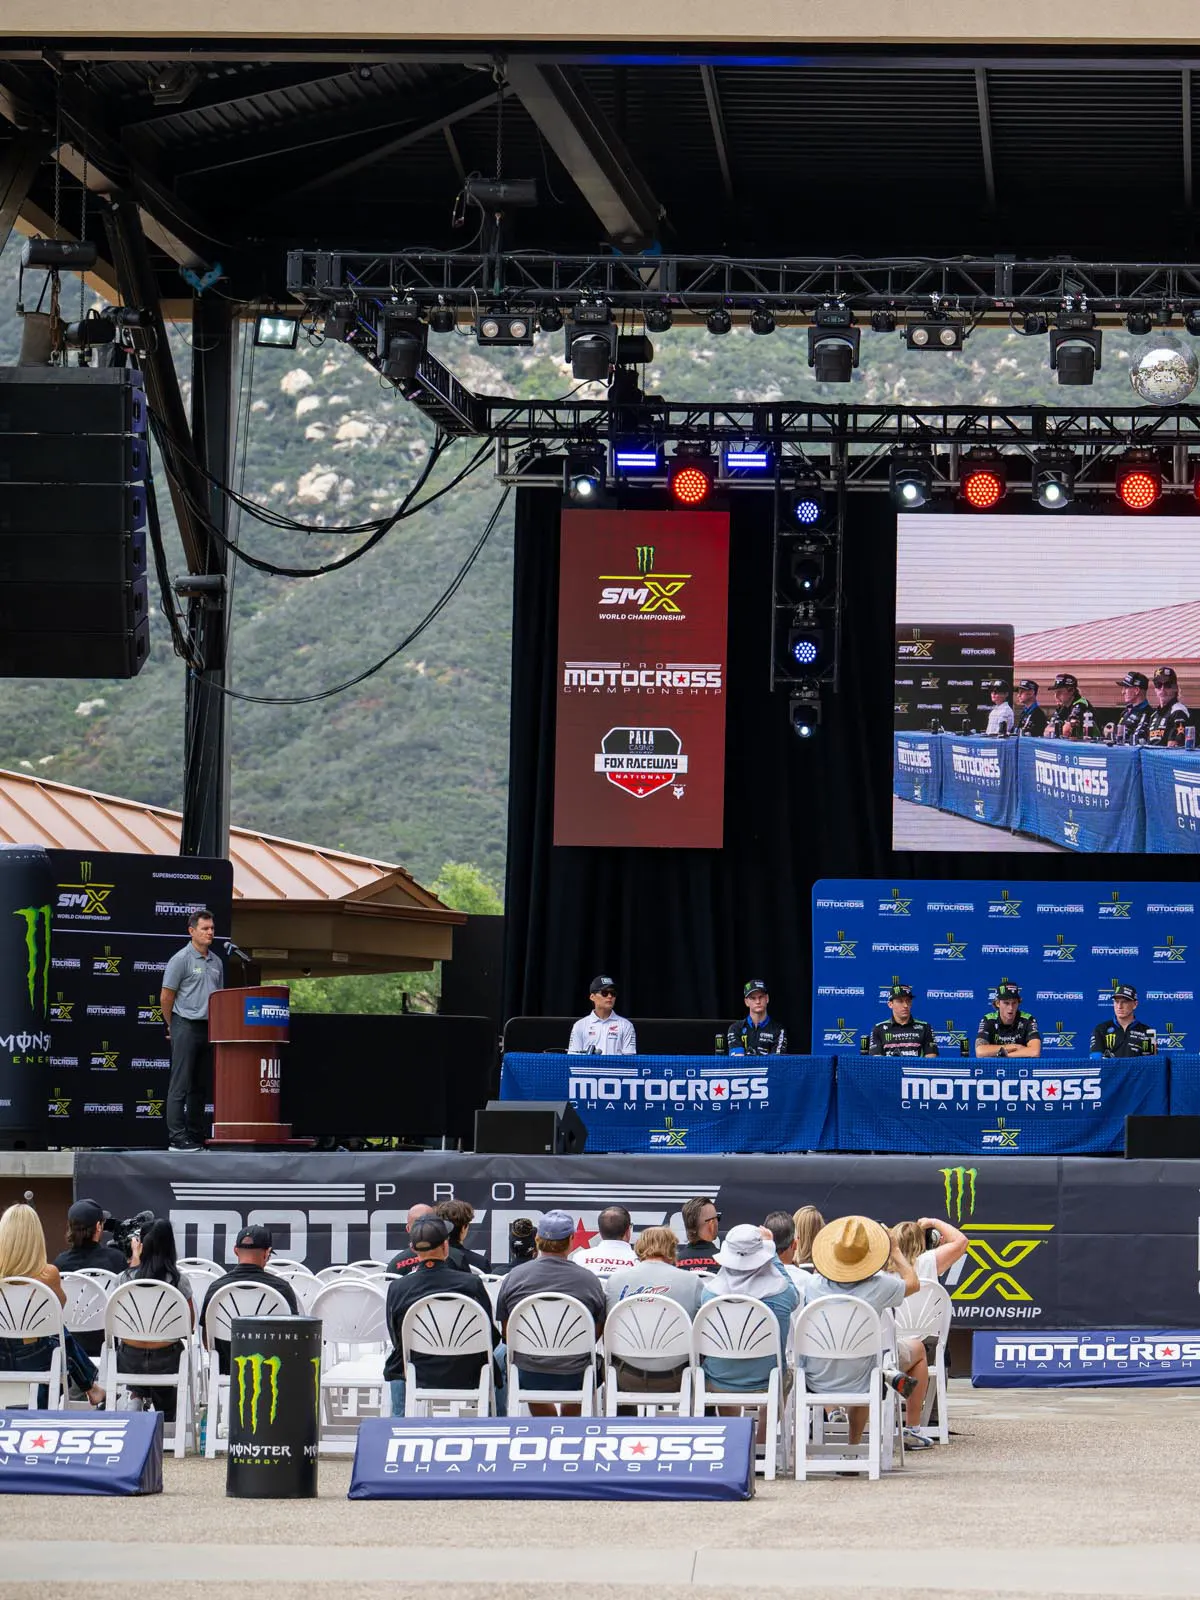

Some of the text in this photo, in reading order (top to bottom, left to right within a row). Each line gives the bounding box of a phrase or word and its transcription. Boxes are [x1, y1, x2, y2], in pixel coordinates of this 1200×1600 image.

[599, 582, 685, 612] SMX
[898, 643, 932, 656] SMX
[564, 670, 722, 687] MOTOCROSS
[564, 687, 722, 695] CHAMPIONSHIP
[629, 730, 654, 744] PALA
[604, 757, 678, 770] FOX RACEWAY
[1057, 754, 1078, 764] PRO
[953, 753, 1000, 778] MOTOCROSS
[1035, 760, 1108, 796] MOTOCROSS
[1037, 784, 1109, 808] CHAMPIONSHIP
[57, 889, 111, 914] SMX
[879, 901, 910, 913] SMX
[988, 903, 1020, 915] SMX
[1098, 905, 1130, 916] SMX
[824, 944, 855, 955] SMX
[934, 946, 966, 958] SMX
[1043, 948, 1075, 960] SMX
[1153, 949, 1185, 960] SMX
[93, 960, 120, 972] SMX
[824, 1032, 856, 1044] SMX
[1043, 1035, 1075, 1046] SMX
[91, 1055, 117, 1067] SMX
[643, 1069, 695, 1077] PRO
[975, 1069, 1028, 1077] PRO
[569, 1078, 768, 1100] MOTOCROSS
[902, 1078, 1101, 1100] MOTOCROSS
[136, 1103, 163, 1115] SMX
[902, 1101, 1101, 1111] CHAMPIONSHIP
[650, 1132, 686, 1145] SMX
[982, 1132, 1018, 1146] SMX
[376, 1183, 514, 1201] PRO
[397, 1256, 420, 1269] HON
[585, 1258, 635, 1266] HONDA
[951, 1306, 1042, 1318] AMPIONSHIP
[516, 1426, 600, 1435] PRO
[230, 1442, 291, 1457] MONSTER
[385, 1437, 726, 1462] MOTOCROSS
[384, 1462, 723, 1473] CHAMPIONSHIP
